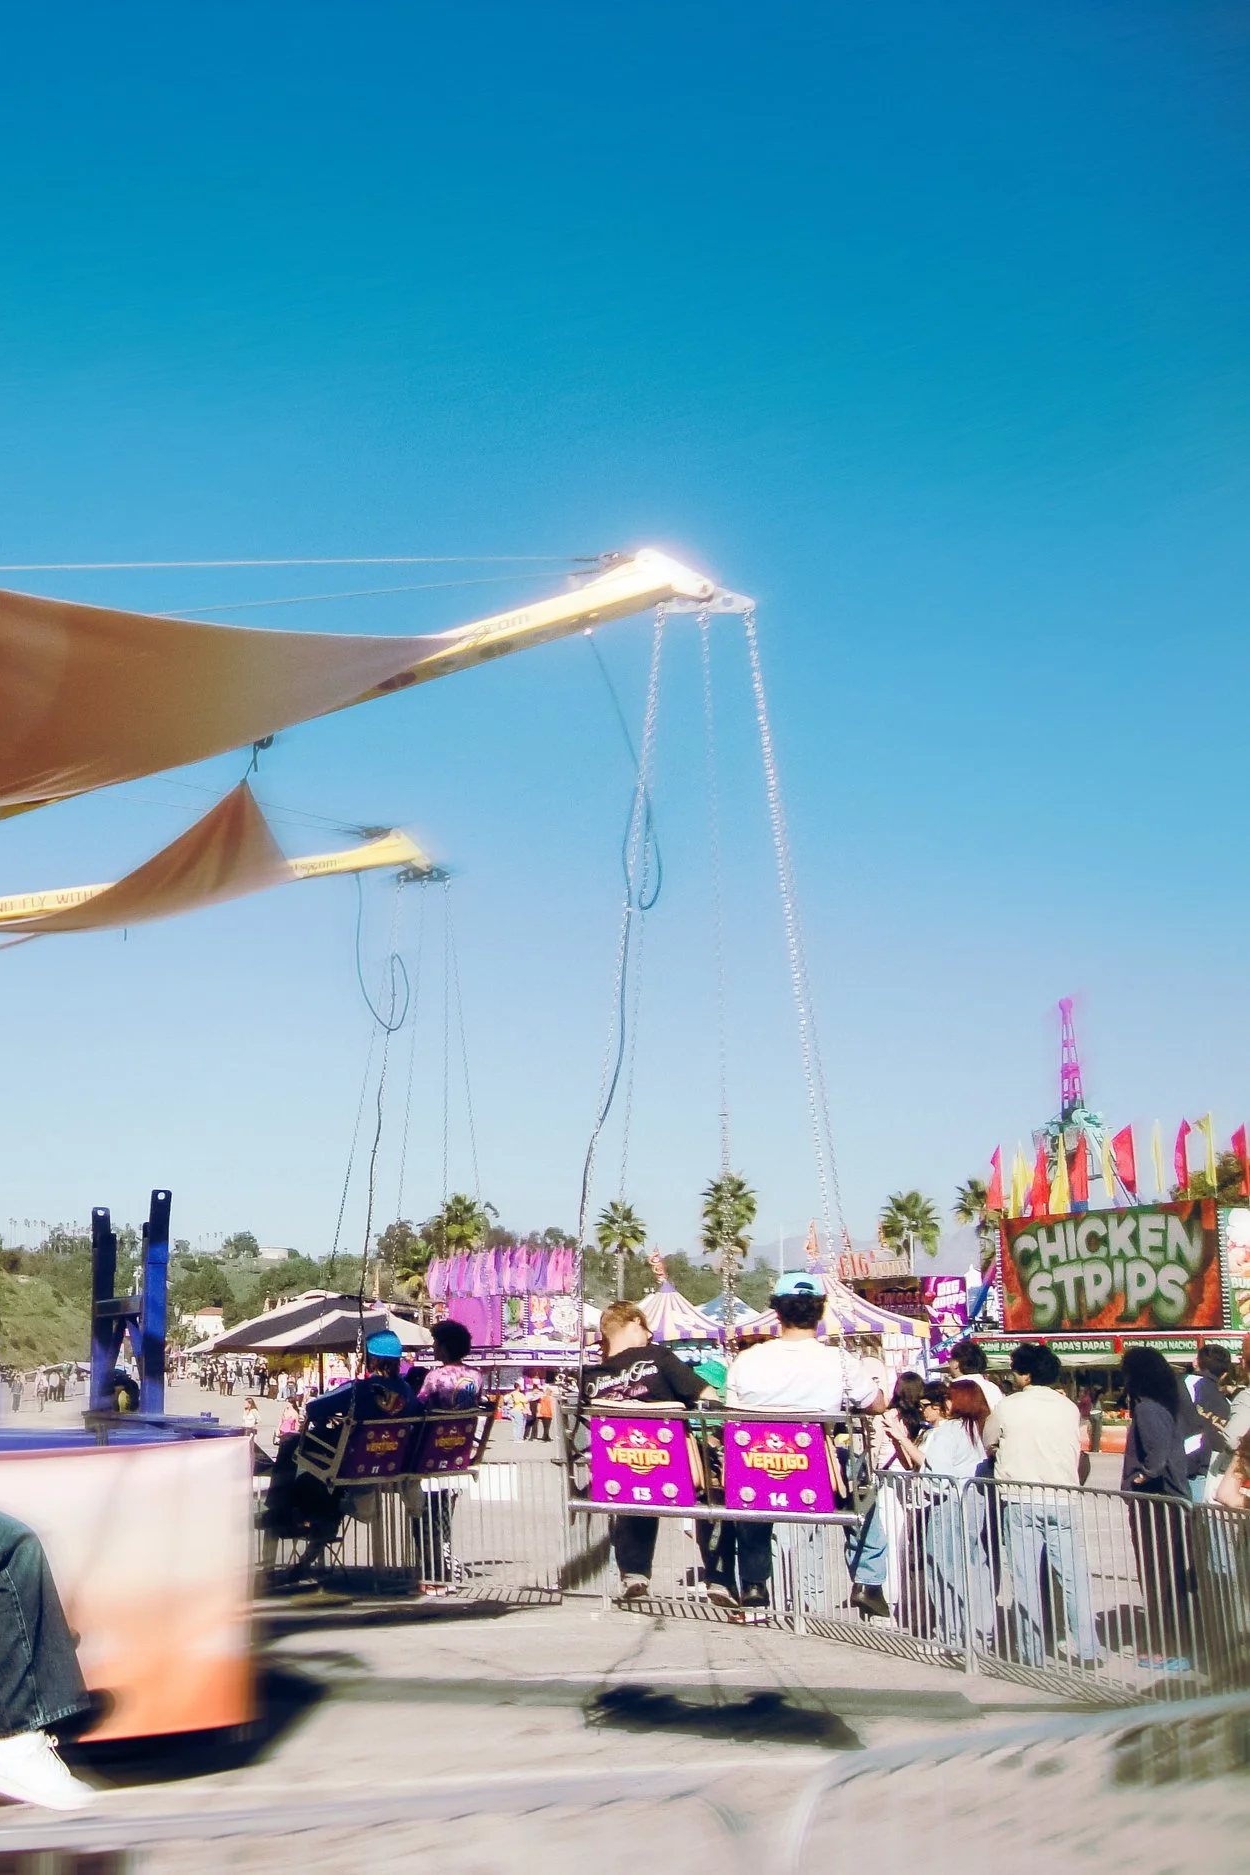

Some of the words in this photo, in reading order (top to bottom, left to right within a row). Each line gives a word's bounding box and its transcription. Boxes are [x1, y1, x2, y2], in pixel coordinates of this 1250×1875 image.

[22, 895, 48, 909] FLY
[1013, 1212, 1204, 1279] CHICKEN
[936, 1279, 961, 1297] BIG
[1028, 1257, 1190, 1325] STRIPS
[1052, 1341, 1081, 1351] PAPA'S
[1081, 1340, 1111, 1351] PAPAS
[1168, 1340, 1198, 1350] NACHOS
[606, 1446, 670, 1466] VERTIGO
[740, 1451, 810, 1471] VERTIGO
[768, 1492, 790, 1508] 14
